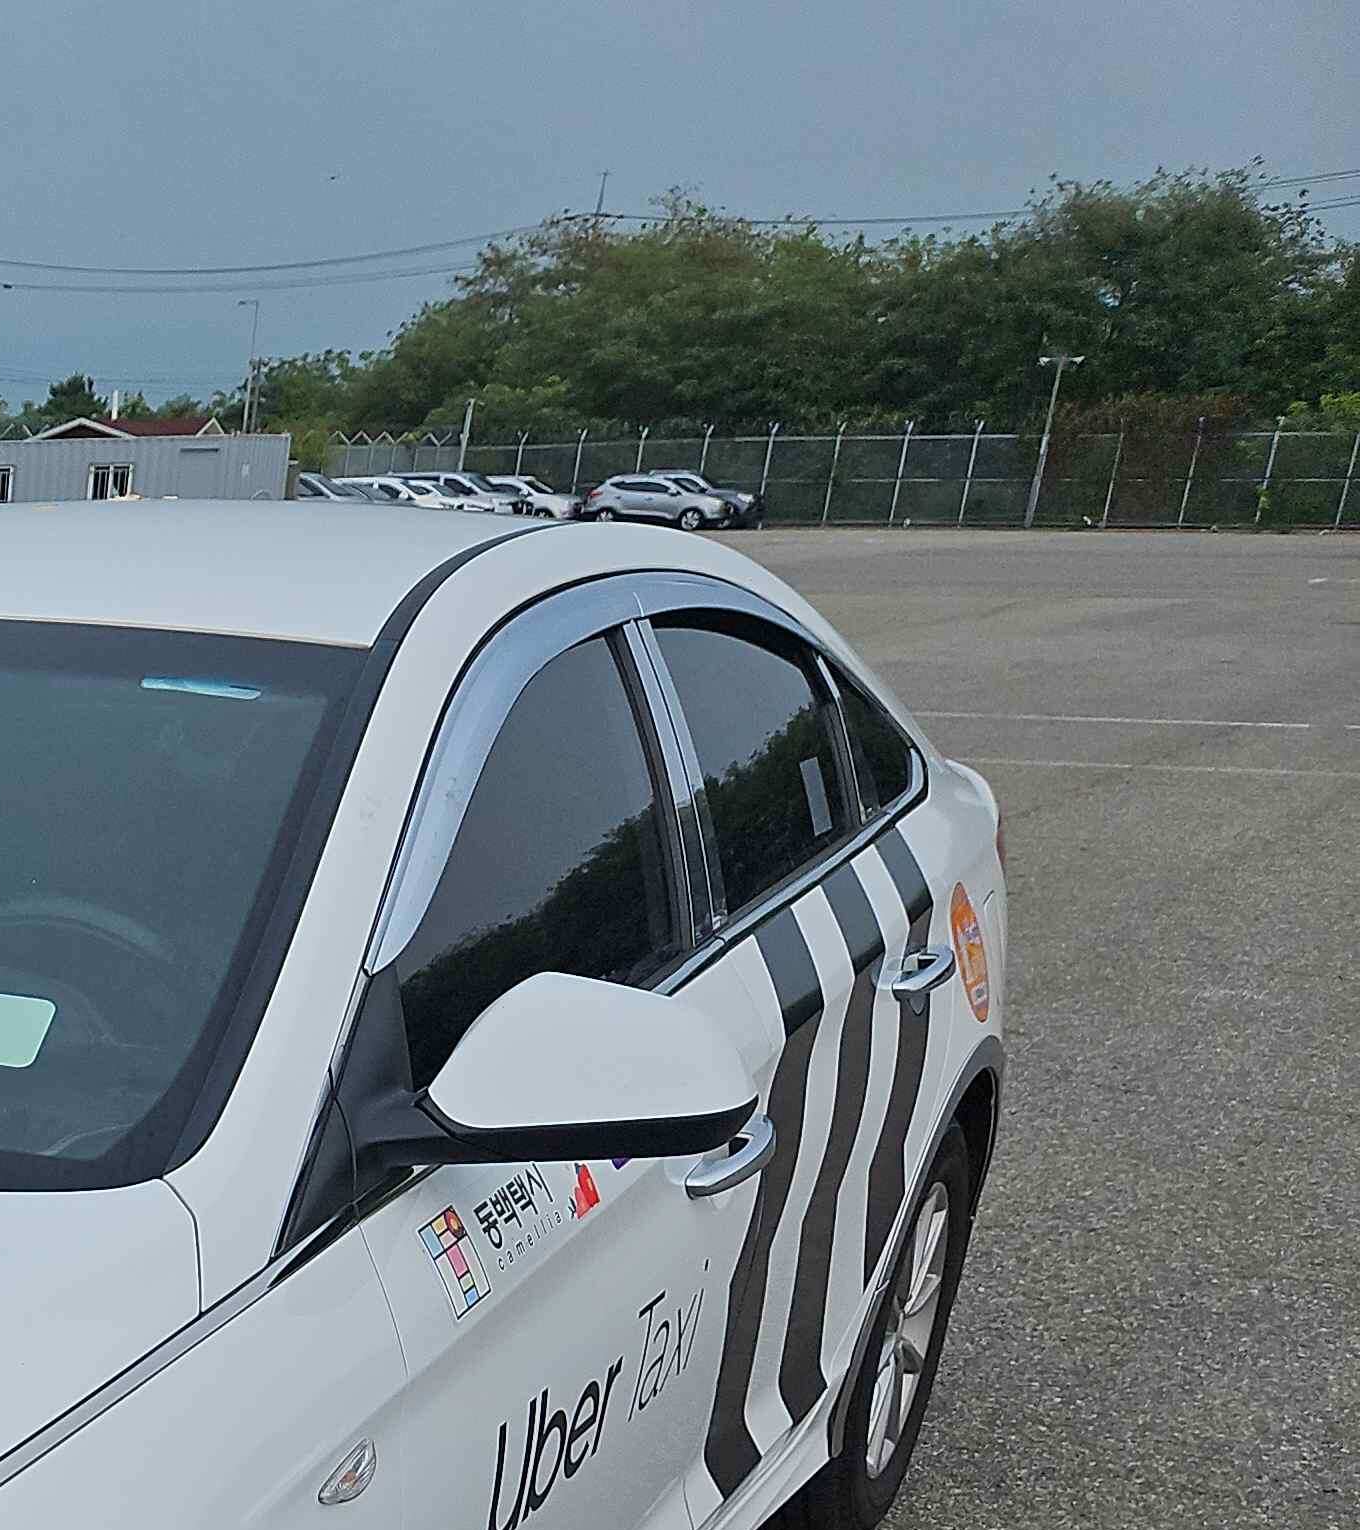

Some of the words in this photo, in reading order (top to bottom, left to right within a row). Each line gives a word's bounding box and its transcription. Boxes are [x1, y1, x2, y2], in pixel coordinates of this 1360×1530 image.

[472, 1162, 554, 1250] 동백택시
[497, 1209, 563, 1271] camellia
[627, 1257, 710, 1423] Taxi
